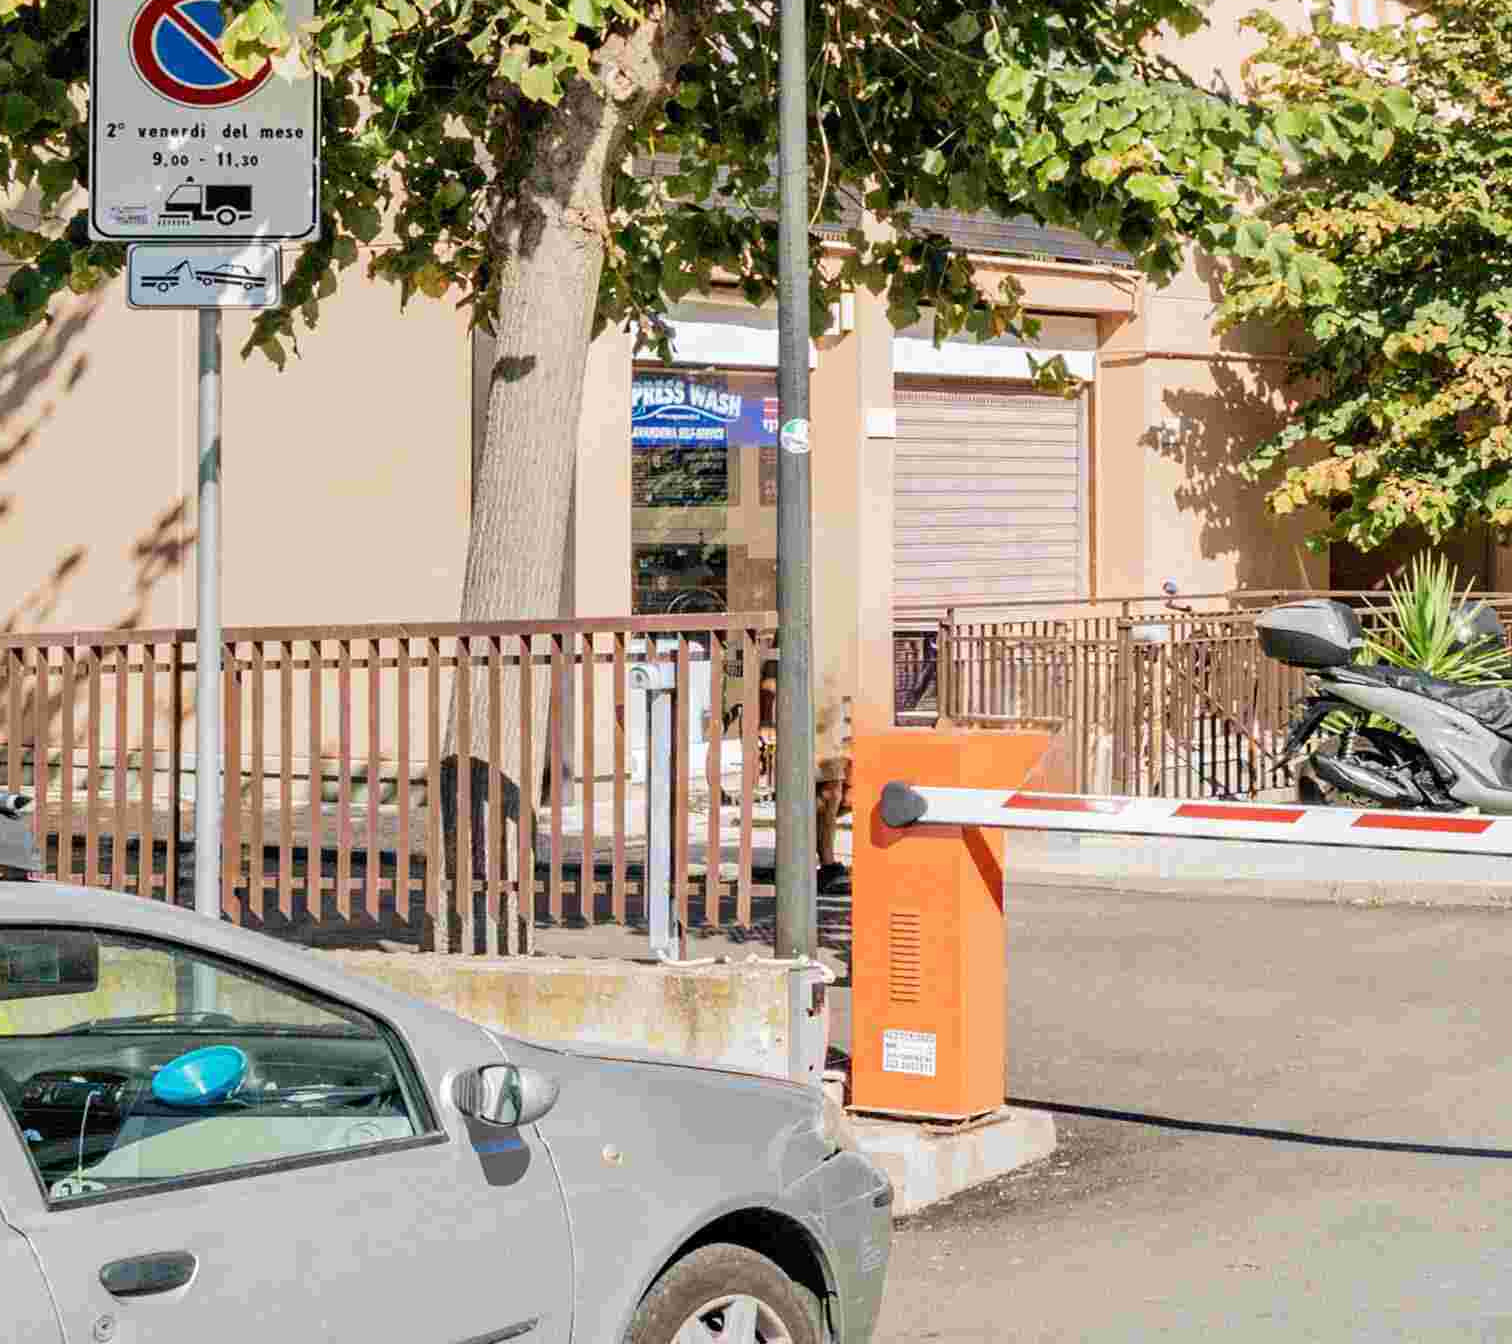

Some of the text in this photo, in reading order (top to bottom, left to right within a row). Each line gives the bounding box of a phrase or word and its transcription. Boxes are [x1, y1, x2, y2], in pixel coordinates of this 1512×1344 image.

[222, 123, 248, 138] del
[260, 126, 304, 138] mese
[152, 151, 189, 167] 9.00
[217, 151, 259, 167] 11.30
[689, 383, 742, 417] WASH
